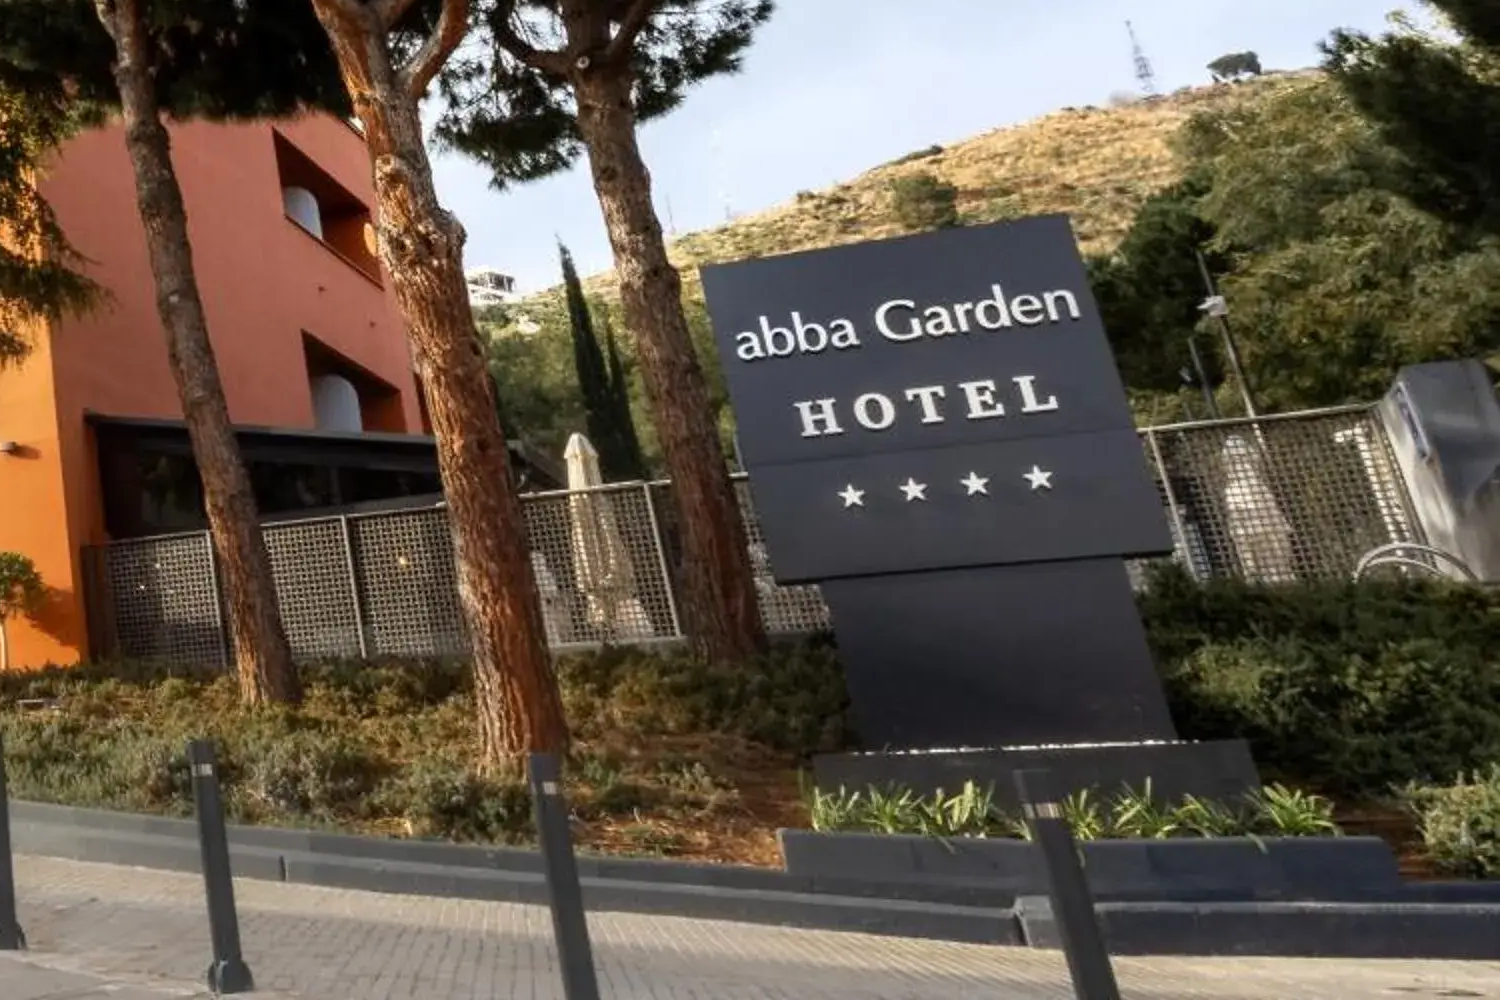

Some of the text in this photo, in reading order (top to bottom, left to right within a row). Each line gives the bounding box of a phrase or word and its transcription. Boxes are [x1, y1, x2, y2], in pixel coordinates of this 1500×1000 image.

[736, 283, 1082, 361] abba Garden
[793, 375, 1059, 437] HOTEL
